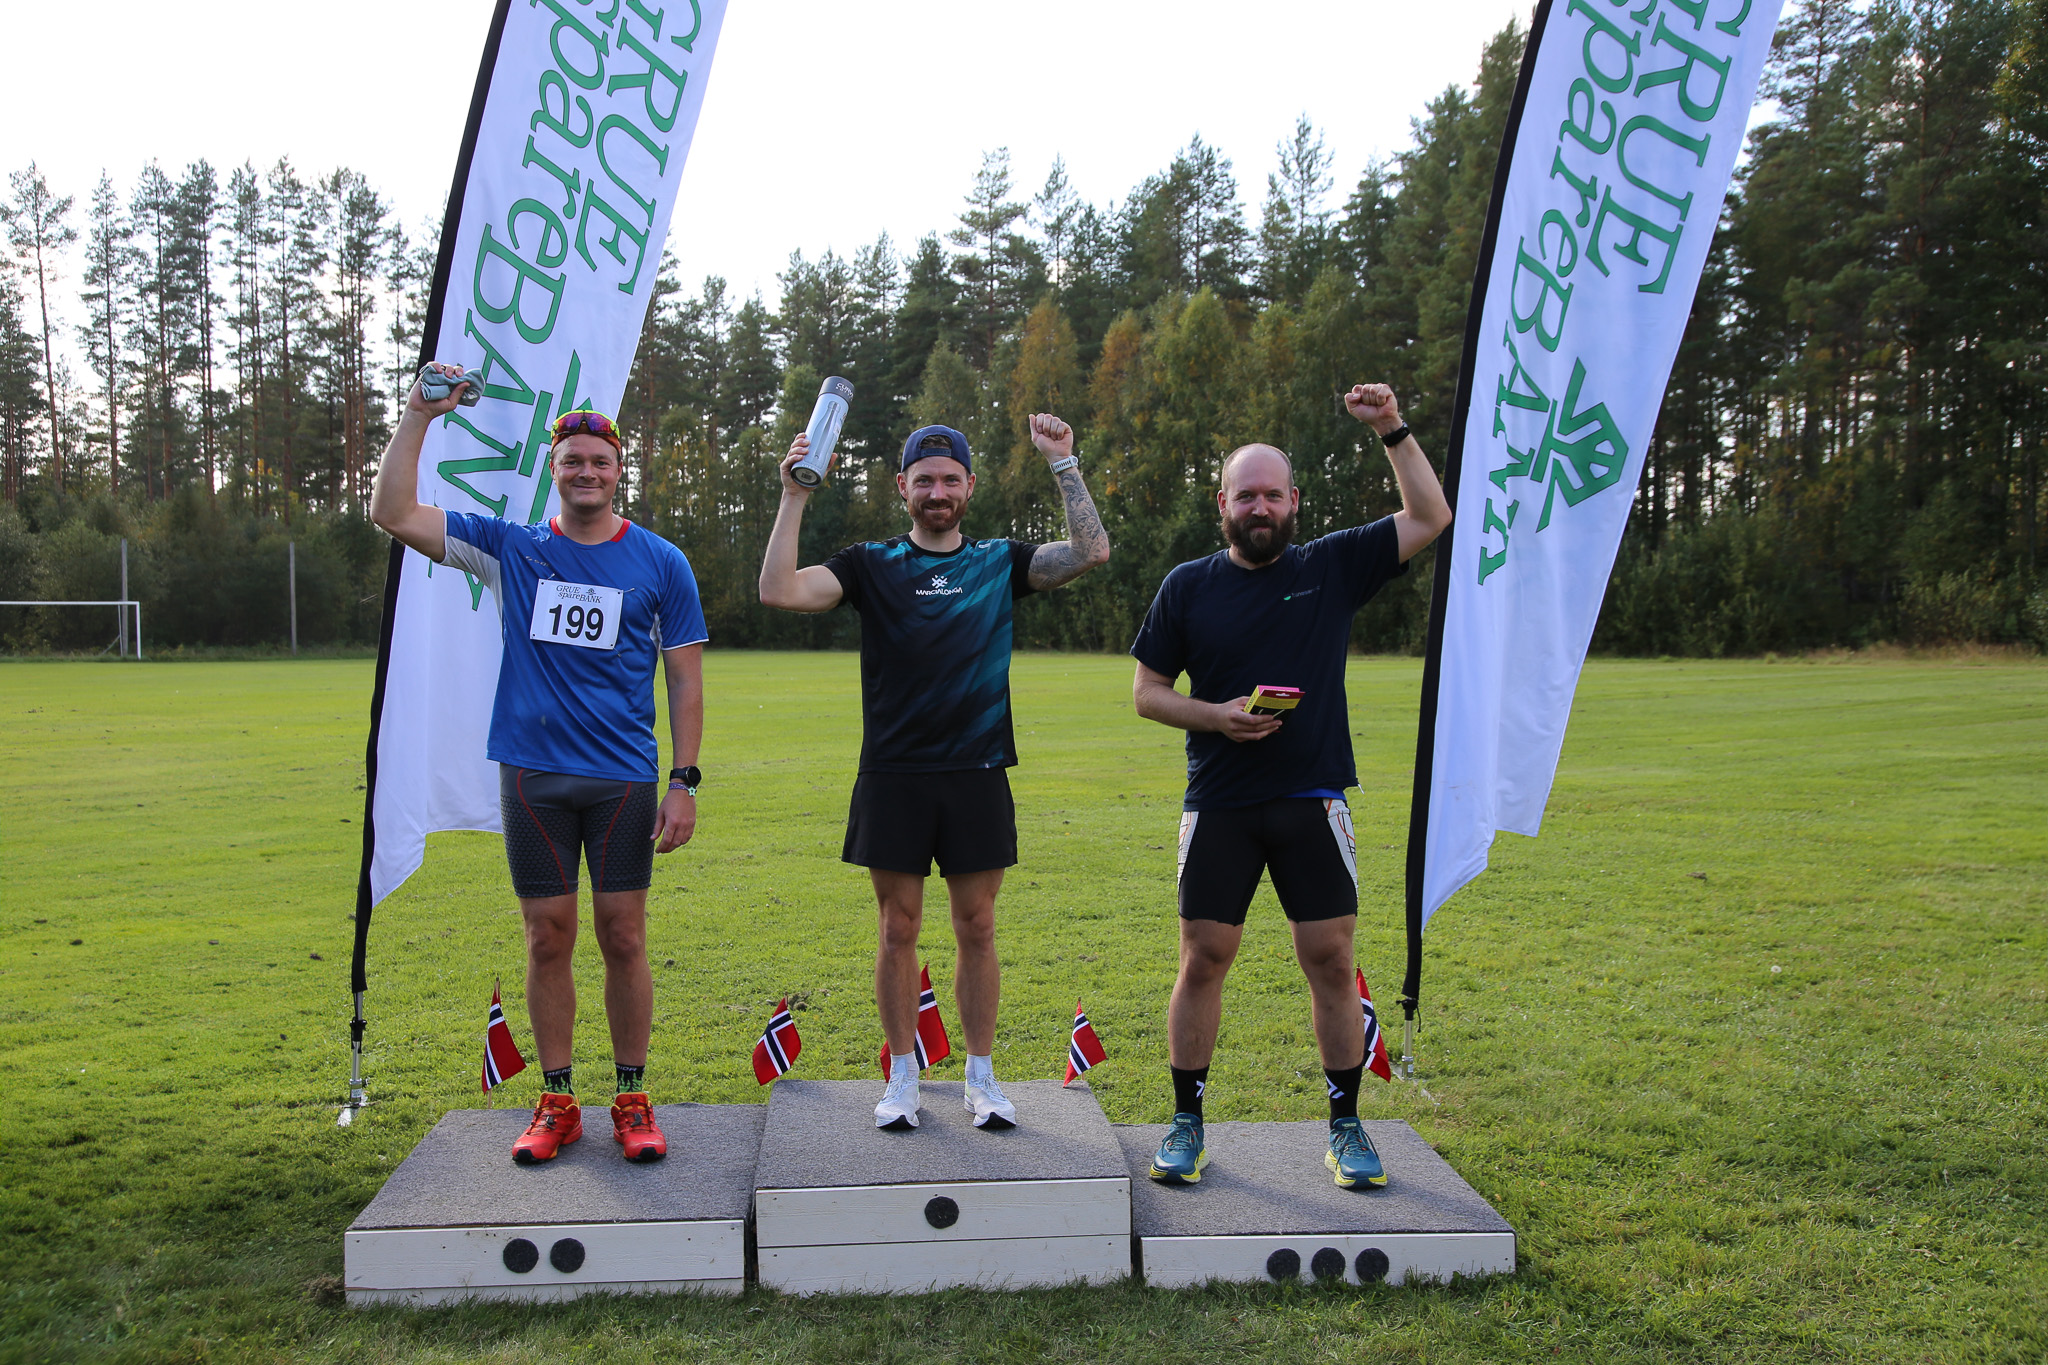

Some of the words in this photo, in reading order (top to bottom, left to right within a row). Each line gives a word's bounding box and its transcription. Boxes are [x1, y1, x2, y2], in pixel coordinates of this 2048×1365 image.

[555, 584, 582, 595] GRUE
[557, 591, 603, 604] spareBANK
[548, 603, 604, 641] 199
